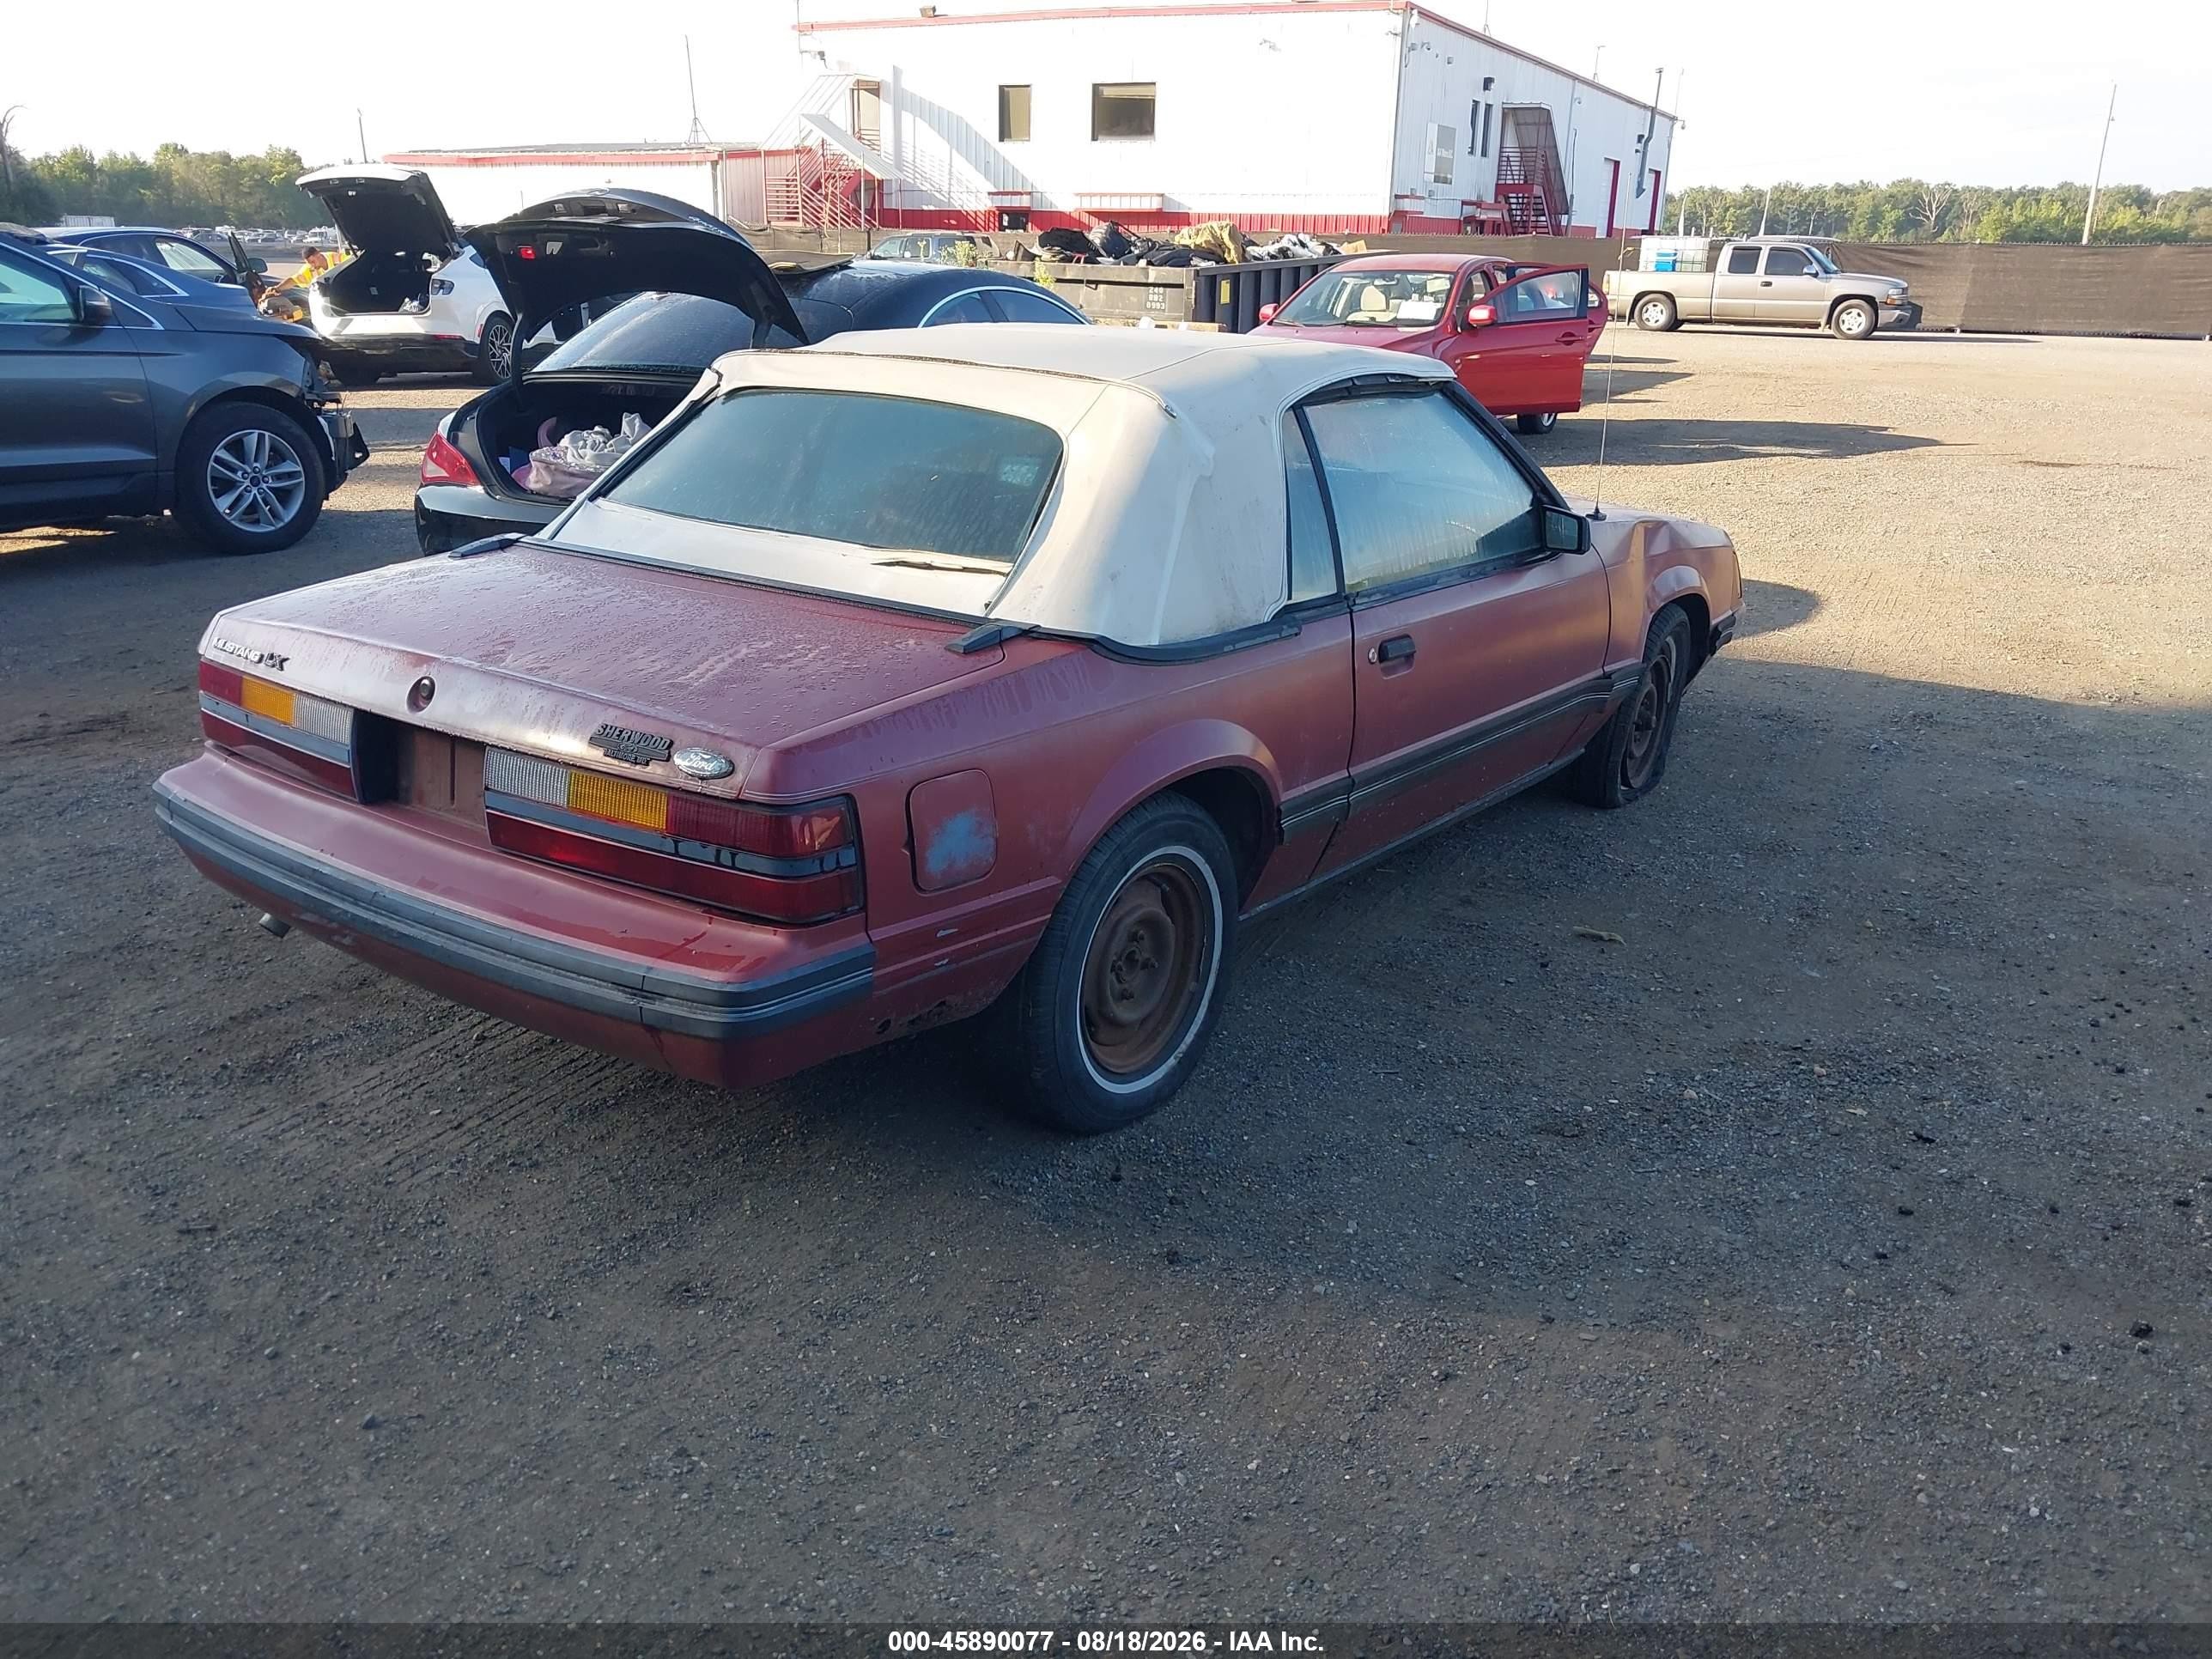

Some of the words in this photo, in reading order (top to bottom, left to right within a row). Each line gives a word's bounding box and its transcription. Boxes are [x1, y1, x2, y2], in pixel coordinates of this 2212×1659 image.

[212, 637, 262, 663] MUSTANG
[264, 652, 290, 672] LX
[596, 723, 672, 750] SHERWOOD
[685, 752, 718, 771] Ford
